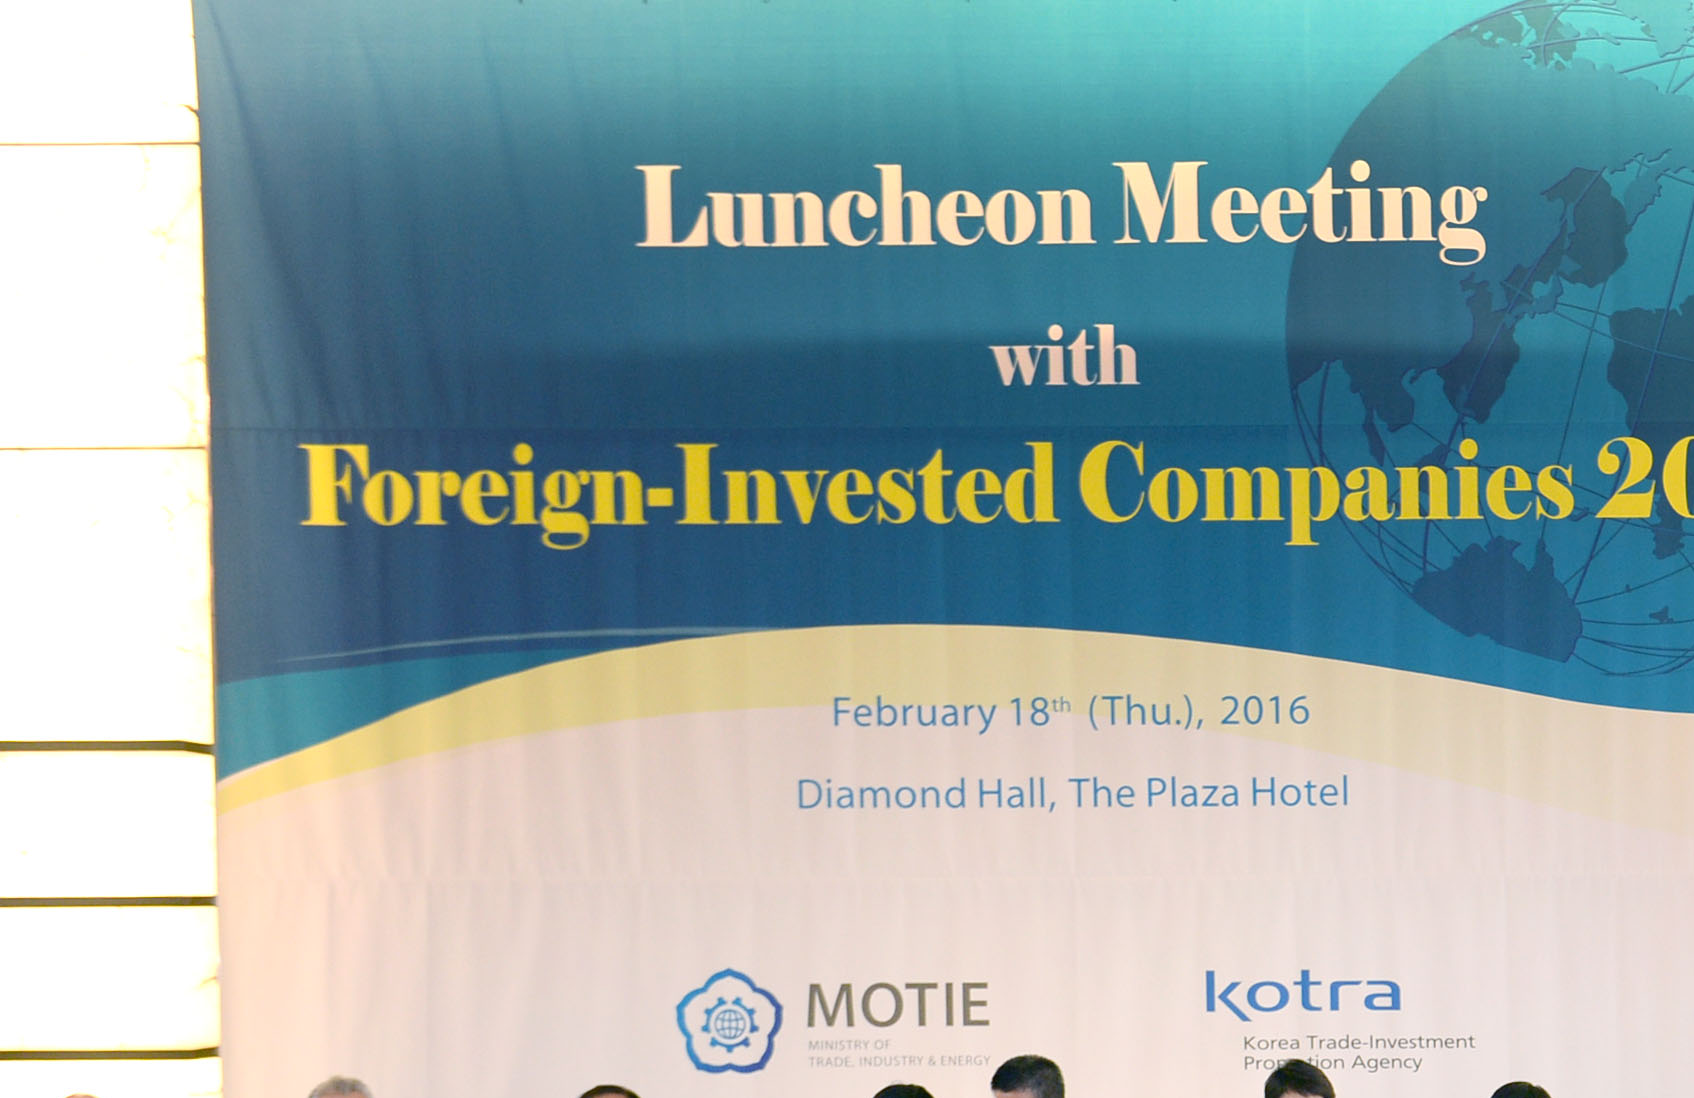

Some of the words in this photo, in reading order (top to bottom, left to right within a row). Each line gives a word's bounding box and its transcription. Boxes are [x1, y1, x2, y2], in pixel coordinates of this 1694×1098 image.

[634, 161, 1096, 248] Luncheon
[1112, 158, 1488, 266] Meeting
[988, 322, 1140, 387] with
[299, 440, 1059, 550] Foreign-Invested
[1079, 437, 1575, 547] Companies
[832, 695, 997, 735] February
[1010, 696, 1072, 727] 18th
[1087, 694, 1205, 732] (Thu.),
[1220, 694, 1311, 726] 2016
[797, 776, 967, 810] Diamond
[978, 776, 1057, 813] Hall,
[1068, 776, 1137, 808] The
[1147, 775, 1240, 808] Plaza
[1251, 774, 1349, 807] Hotel
[806, 981, 991, 1028] MOTIE
[1205, 969, 1402, 1022] kotra
[808, 1039, 870, 1051] MINISTRY
[874, 1038, 892, 1050] OF
[859, 1055, 924, 1067] INDUSTRY
[927, 1056, 937, 1066] &
[940, 1055, 991, 1066] ENERGY
[1243, 1036, 1300, 1050] Korea
[1306, 1034, 1476, 1050] Trade-Investment
[1244, 1055, 1345, 1071] Protion
[1351, 1054, 1423, 1073] Agency
